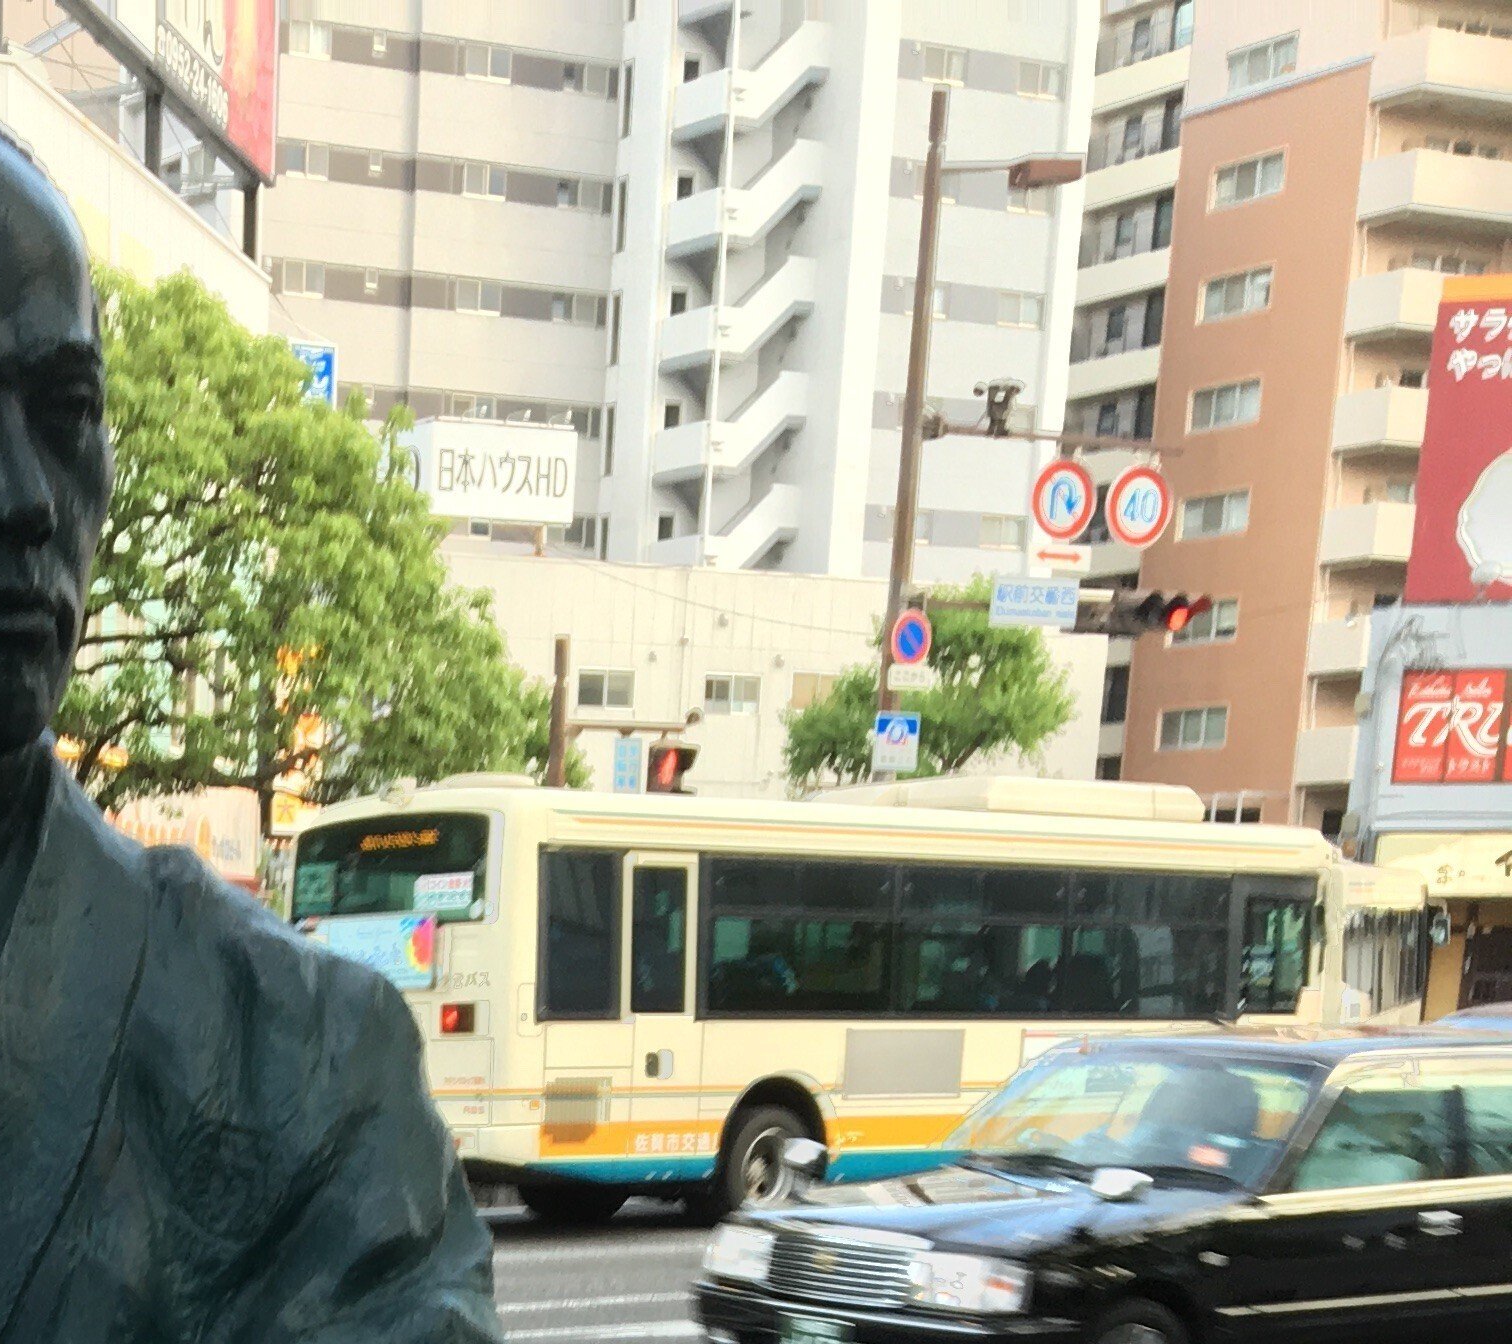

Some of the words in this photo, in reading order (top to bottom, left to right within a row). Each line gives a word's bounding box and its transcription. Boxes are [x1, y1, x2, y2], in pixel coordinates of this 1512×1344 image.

[1449, 308, 1512, 344] サラ
[439, 447, 568, 499] 日本ハウスHD
[1123, 488, 1159, 524] 40
[1403, 692, 1512, 757] TRU
